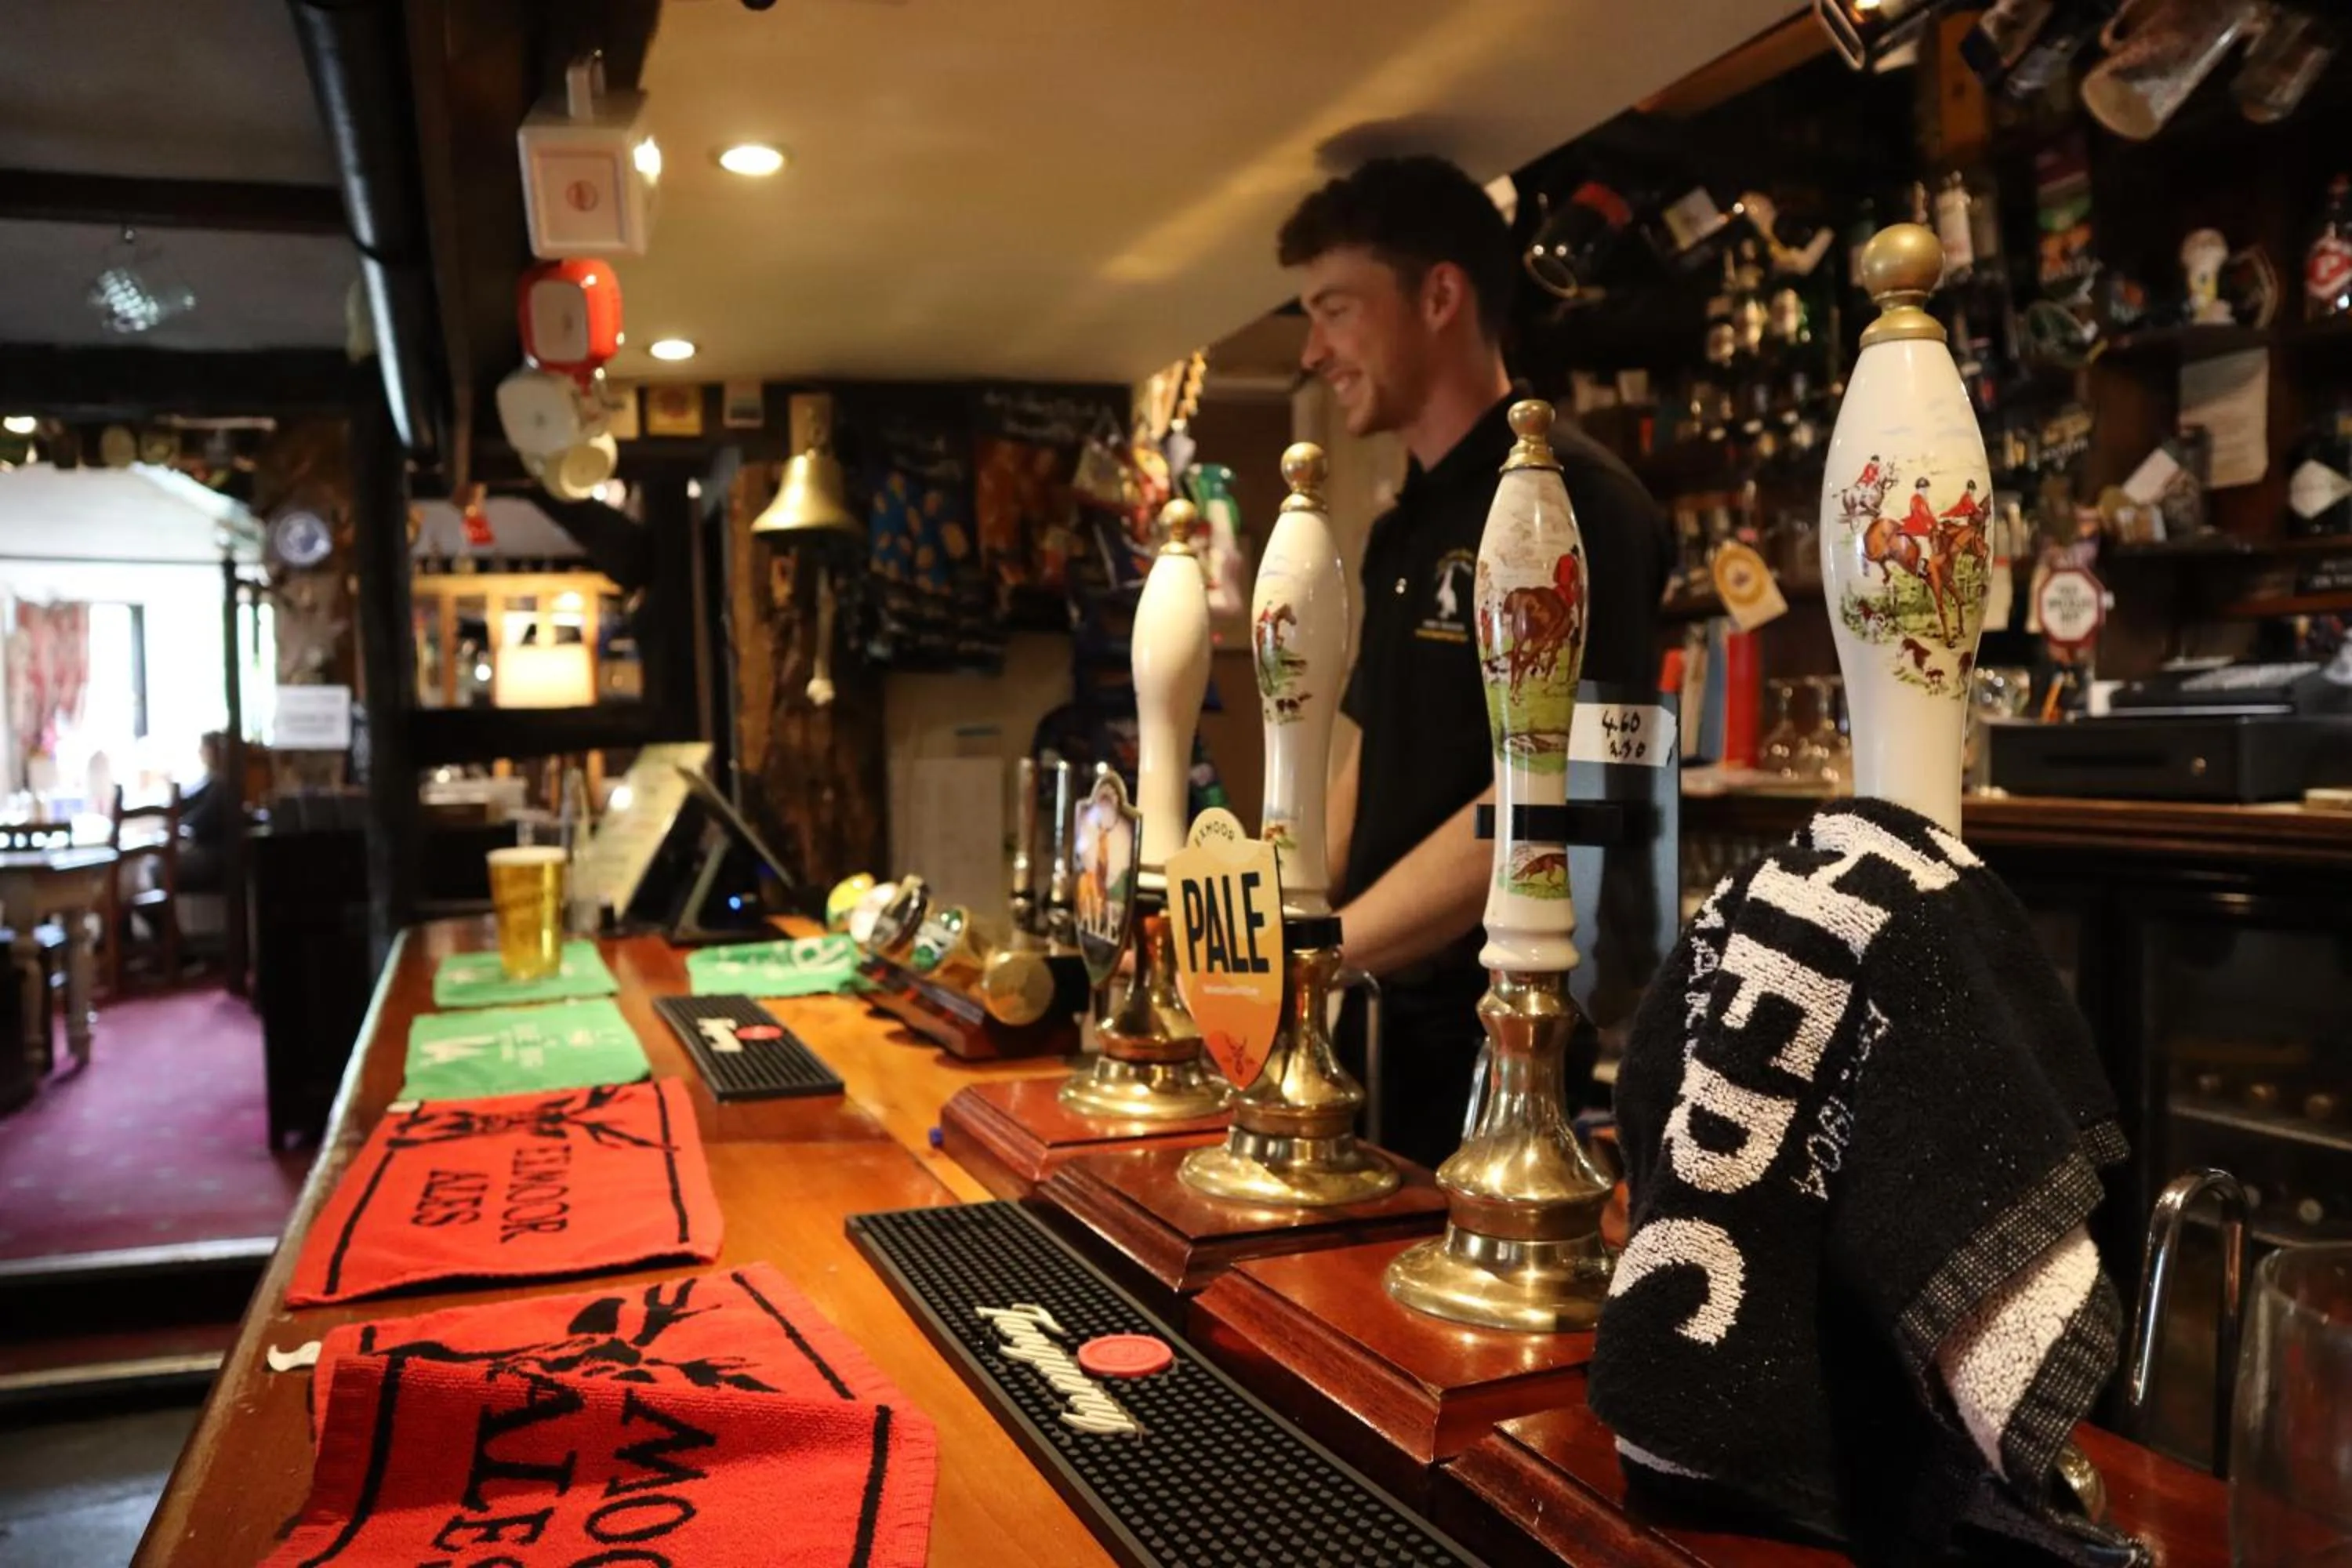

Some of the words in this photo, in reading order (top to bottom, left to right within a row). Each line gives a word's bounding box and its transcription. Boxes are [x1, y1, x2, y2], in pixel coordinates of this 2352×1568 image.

[1180, 871, 1270, 974] PALE
[410, 1168, 490, 1227] ALES
[1789, 1095, 1857, 1200] 1904
